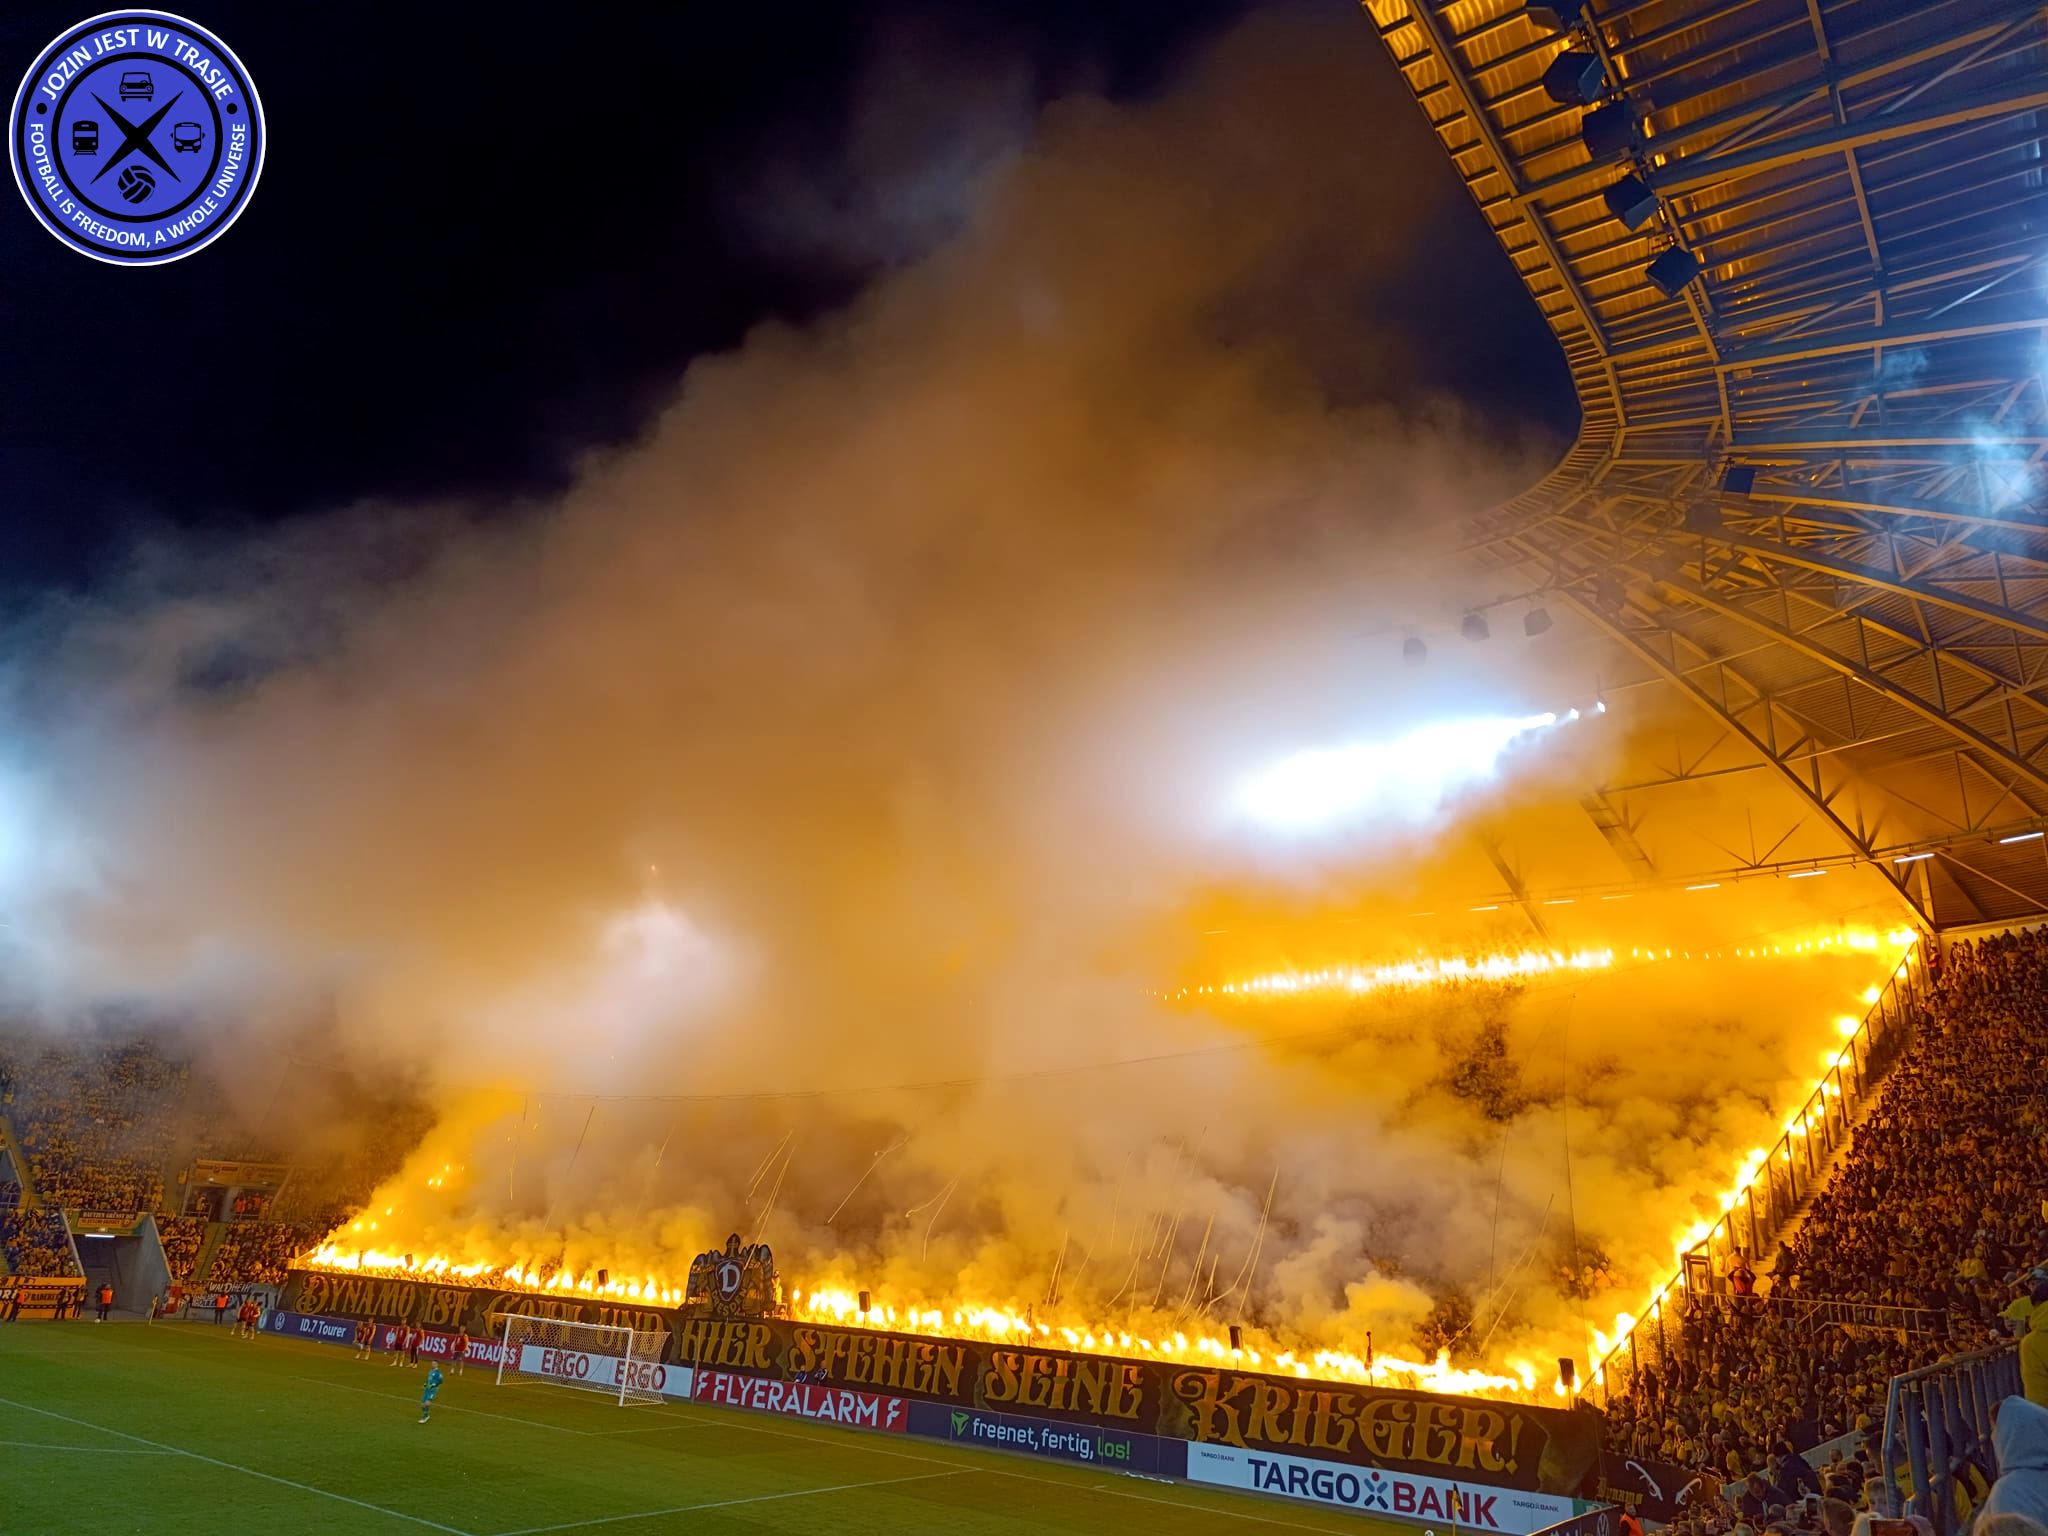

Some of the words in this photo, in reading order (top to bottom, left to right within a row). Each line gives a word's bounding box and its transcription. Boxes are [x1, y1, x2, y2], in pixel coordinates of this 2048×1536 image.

[299, 1318, 318, 1334] ID.7
[318, 1321, 348, 1339] Tourer
[464, 1342, 517, 1365] STRAUSS
[540, 1349, 590, 1379] ERGO
[295, 1272, 417, 1318] DYNAMO
[421, 1285, 473, 1327] IST
[596, 1306, 667, 1355] UND
[680, 1318, 772, 1370] HIER
[788, 1327, 967, 1396] STEHEN
[983, 1350, 1144, 1420] SEINE
[1172, 1369, 1524, 1476] KRIEGER!
[613, 1358, 667, 1391] ERGO
[712, 1373, 881, 1427] FLYERALARM
[972, 1417, 1040, 1451] freenet,
[1040, 1430, 1095, 1461] fertig,
[1097, 1436, 1131, 1461] los!
